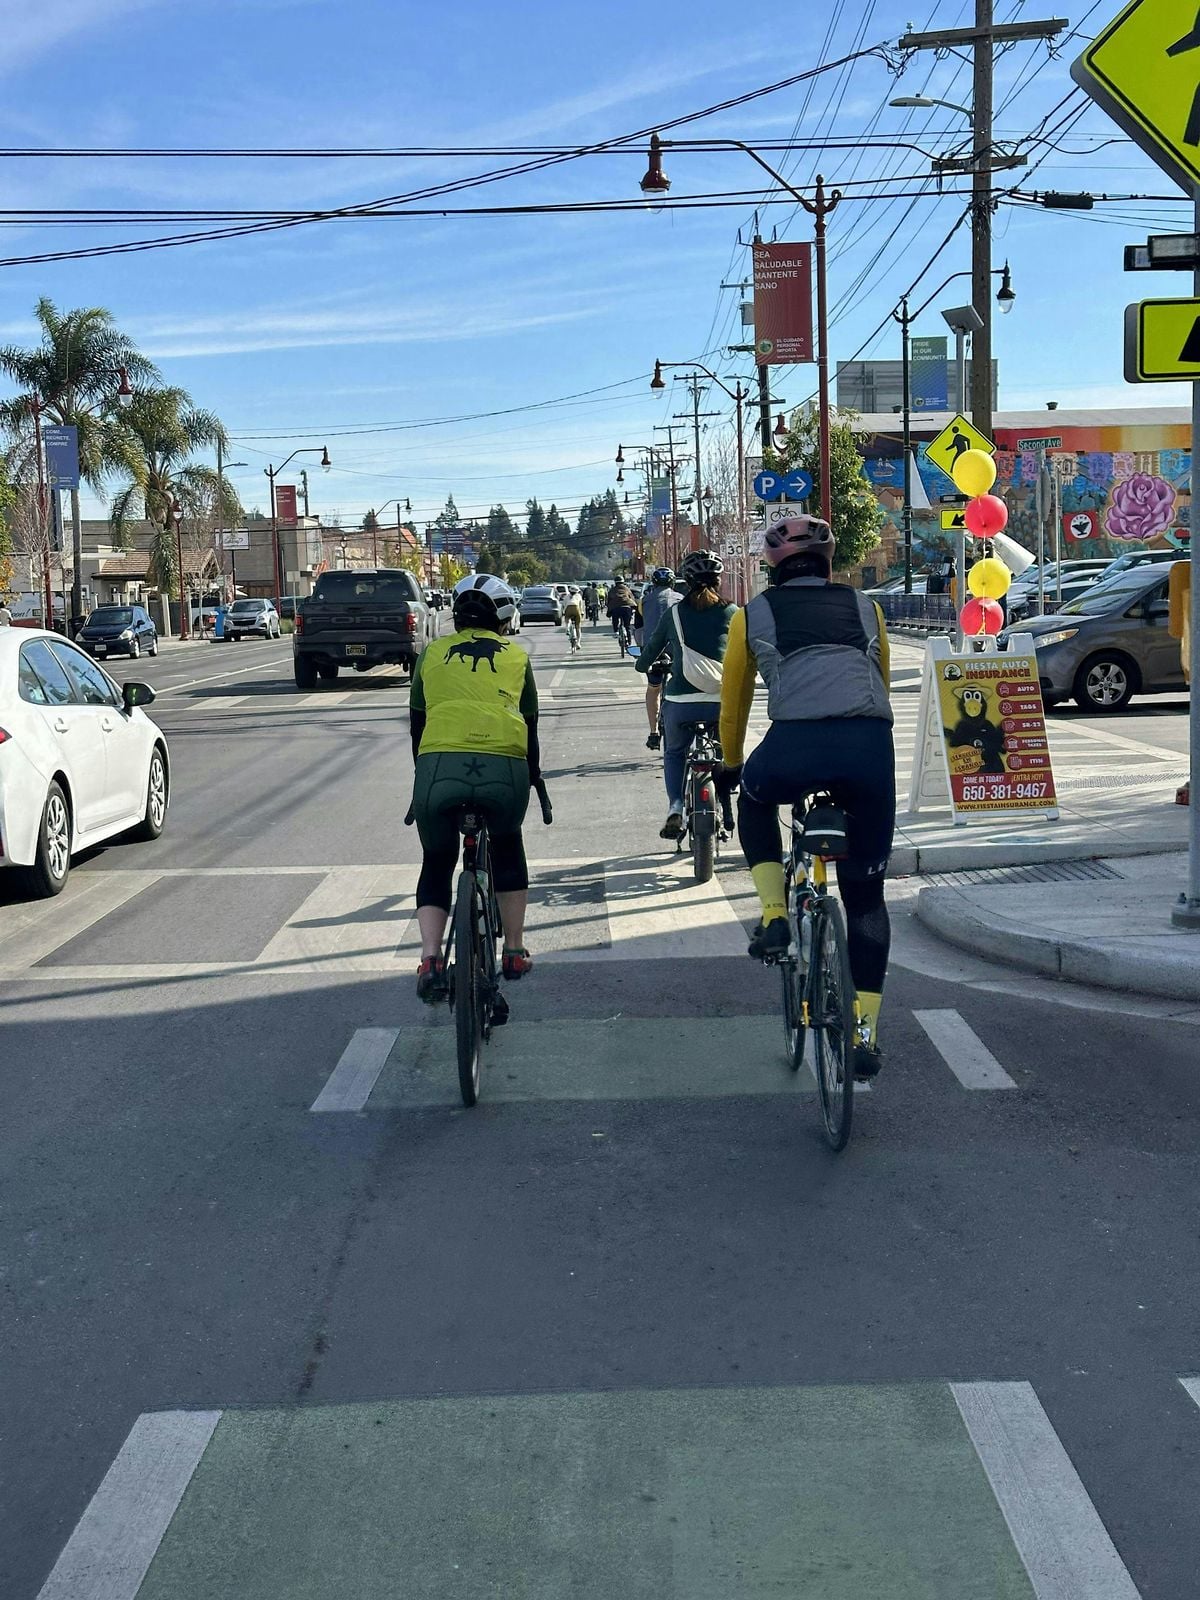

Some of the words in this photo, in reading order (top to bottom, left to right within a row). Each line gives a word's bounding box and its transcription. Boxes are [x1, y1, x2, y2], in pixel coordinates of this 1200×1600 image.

[754, 260, 803, 269] SALUDABLE
[754, 271, 798, 280] MANTENTE
[754, 282, 778, 290] SANO
[1020, 440, 1046, 450] Second
[1047, 439, 1061, 448] Ave
[761, 477, 775, 495] P
[306, 615, 403, 624] FORD
[965, 661, 998, 670] FIESTA
[1001, 660, 1029, 669] AUTO
[965, 668, 1031, 680] INSURANCE
[962, 776, 978, 784] COME
[962, 782, 1047, 801] 650-381-9467
[957, 800, 1055, 810] WWW.FIESTAINSURANCE.COM
